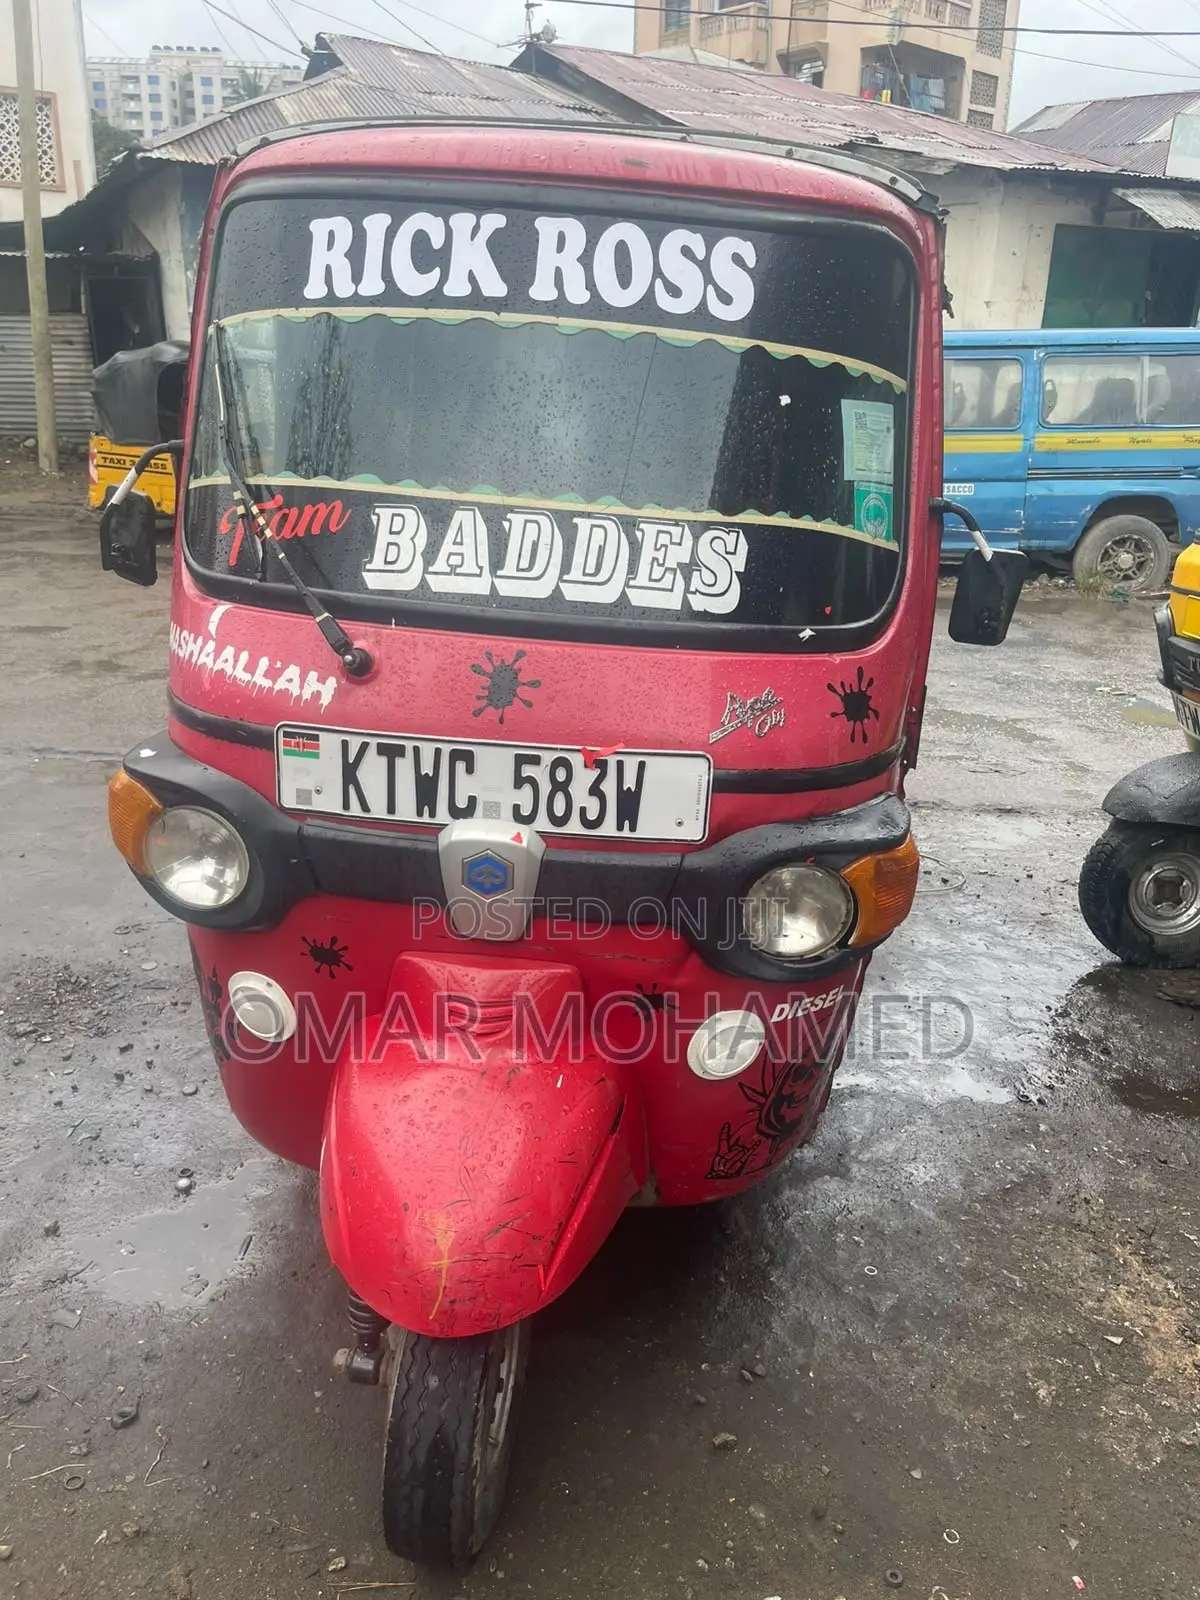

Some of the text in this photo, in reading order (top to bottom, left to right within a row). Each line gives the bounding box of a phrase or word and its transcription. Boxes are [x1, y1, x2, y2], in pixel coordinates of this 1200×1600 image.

[303, 212, 756, 321] RICK ROSS
[101, 456, 127, 466] TAXI
[361, 503, 749, 614] BADDES
[341, 738, 478, 823] KTWC
[512, 752, 647, 833] 583W
[770, 984, 844, 1023] DIESEL
